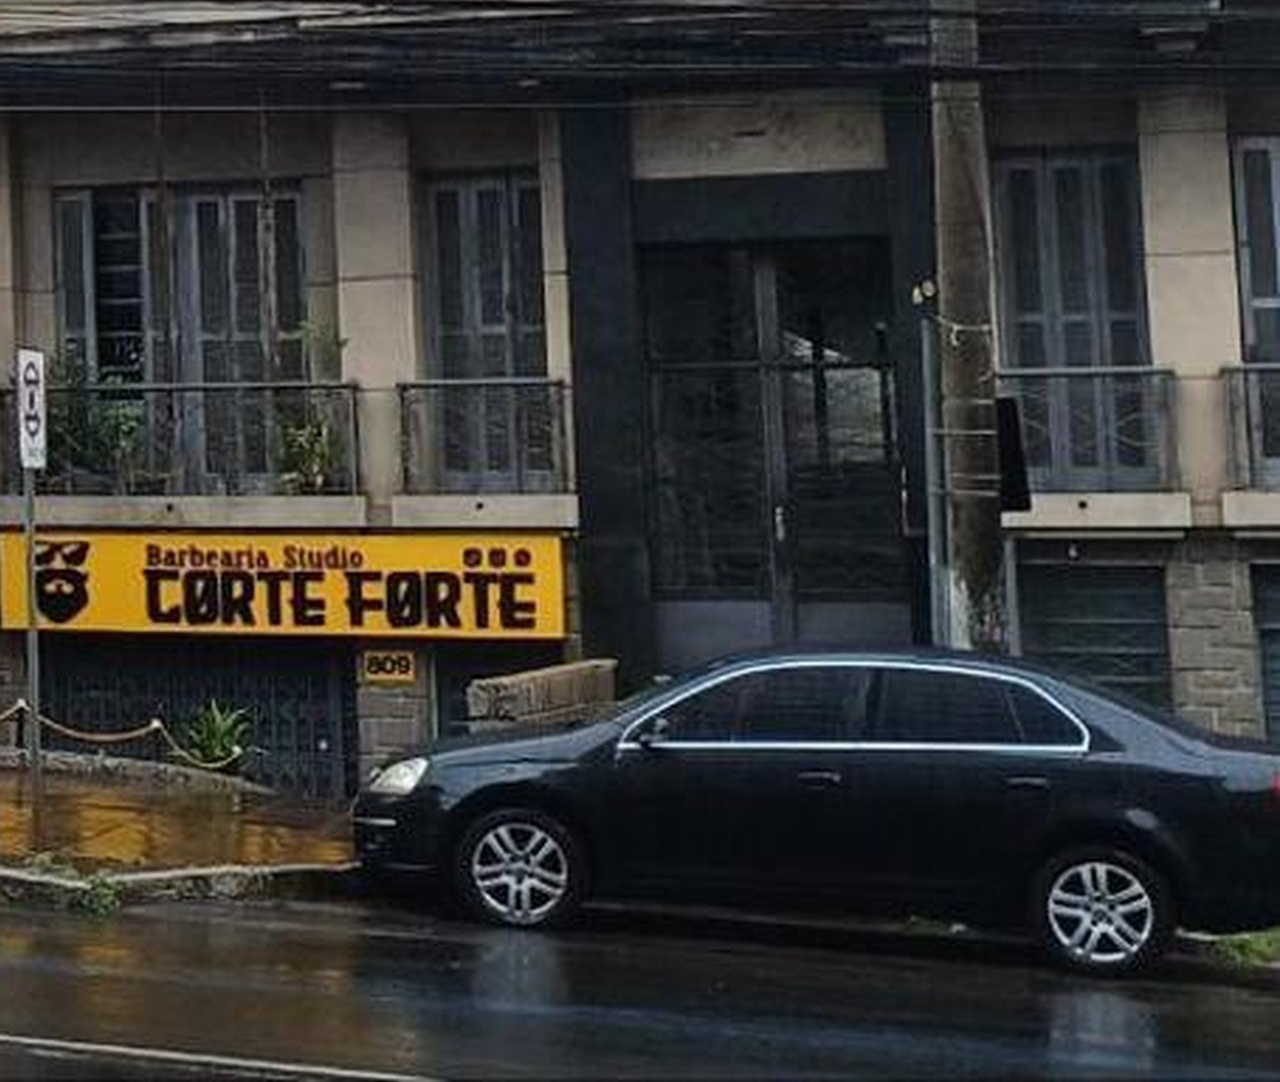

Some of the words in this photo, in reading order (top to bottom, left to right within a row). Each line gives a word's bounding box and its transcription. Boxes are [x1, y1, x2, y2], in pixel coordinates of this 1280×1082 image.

[145, 543, 270, 569] Barbearia
[282, 544, 364, 569] Studio
[366, 655, 411, 675] 809
